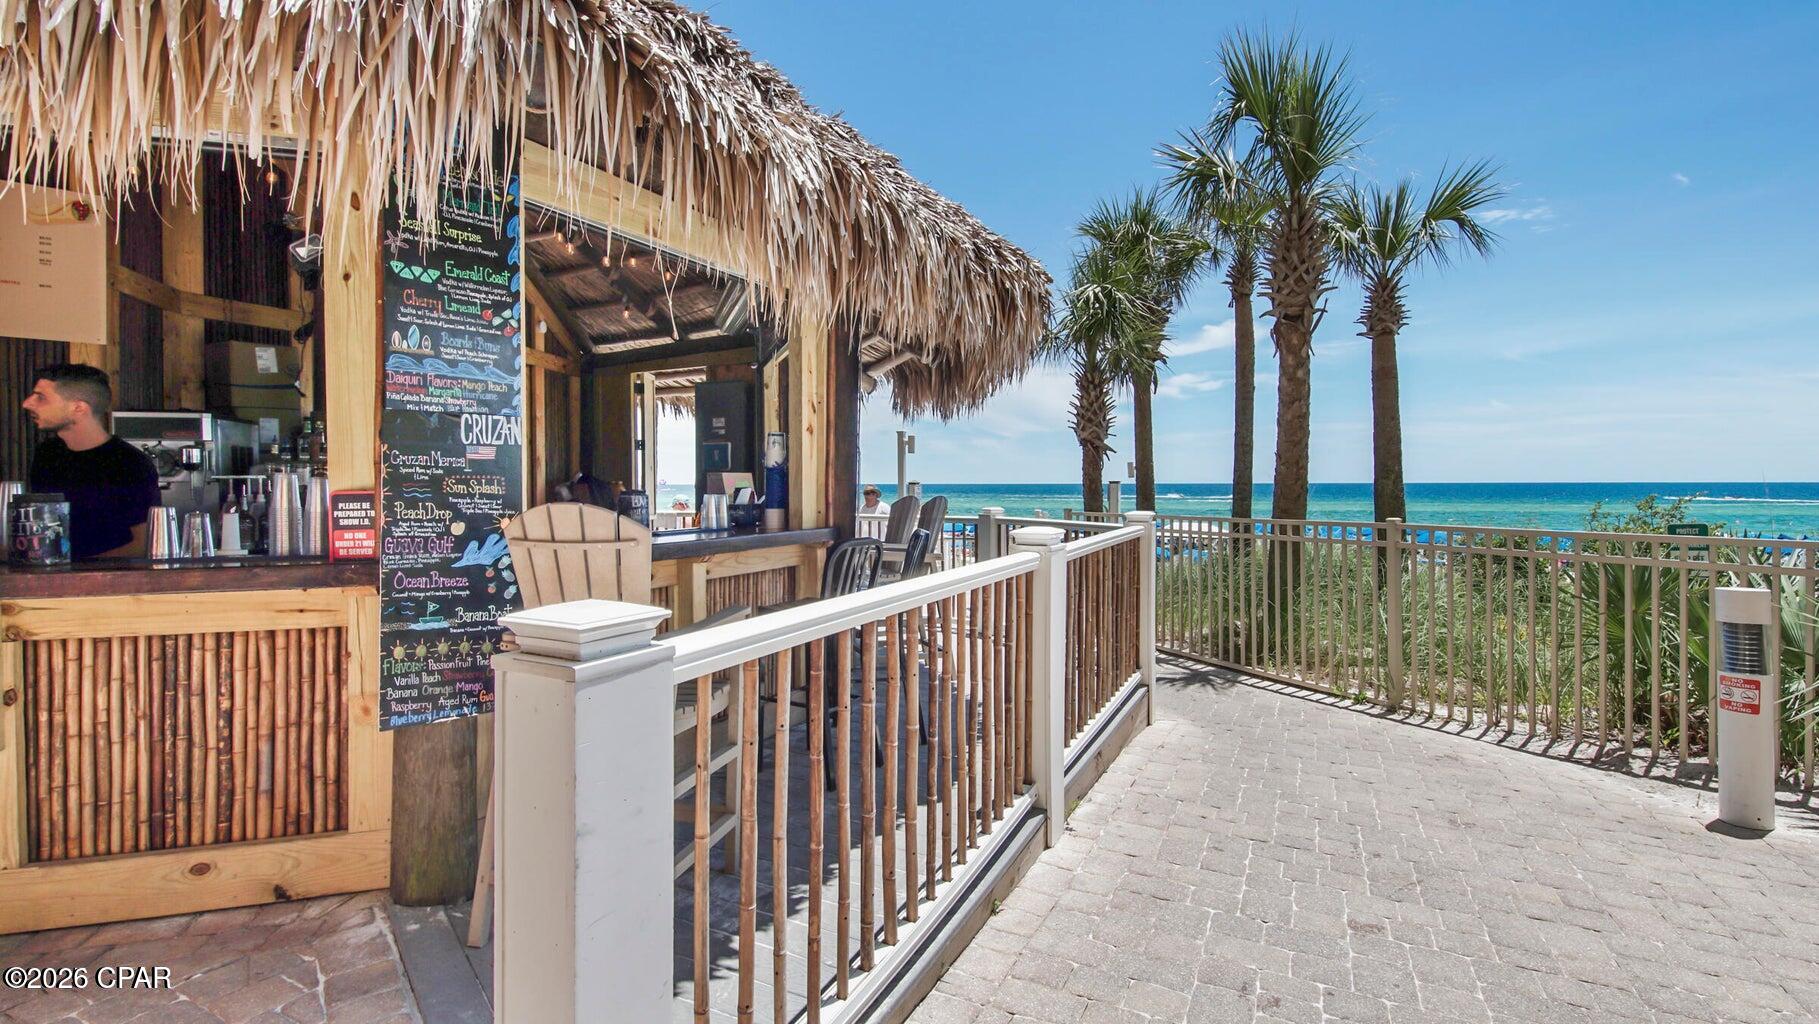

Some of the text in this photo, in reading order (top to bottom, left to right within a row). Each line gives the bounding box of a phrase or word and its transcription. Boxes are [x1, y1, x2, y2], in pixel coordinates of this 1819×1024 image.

[442, 221, 482, 244] Surprise
[445, 260, 511, 286] Emerald Coast
[403, 288, 442, 314] Cherry
[440, 331, 473, 349] Boards
[385, 370, 508, 394] Daiquiri Flavors: Mango Peach
[385, 391, 400, 400] Piña
[406, 403, 419, 411] Mix
[423, 404, 445, 413] Match
[460, 413, 523, 446] CRUZAN
[390, 449, 465, 468] Cruzan Merica
[446, 478, 503, 498] Sun Splash
[333, 510, 376, 518] PREPARED TO
[338, 501, 371, 510] PLEASE BE
[394, 501, 453, 525] Peach Drop
[339, 518, 371, 526] SHOW I.D.
[335, 540, 355, 548] UNDER
[355, 540, 362, 548] 21
[343, 532, 353, 540] NO
[384, 536, 455, 554] Guava Gulf
[339, 548, 373, 556] BE SERVED
[393, 570, 470, 590] Ocean Breeze
[455, 606, 489, 623] Banana
[383, 658, 426, 676] Flavors:
[393, 673, 420, 687] Vanilla
[421, 671, 442, 684] Peach
[1722, 680, 1756, 689] SMOKING
[386, 681, 484, 701] Banana Orange Mango
[390, 700, 432, 714] Raspberry
[438, 696, 460, 710] Aged
[461, 694, 478, 705] Rum
[1724, 704, 1752, 713] VAPING
[390, 711, 432, 727] Blueberry
[433, 704, 479, 720] Lemonade
